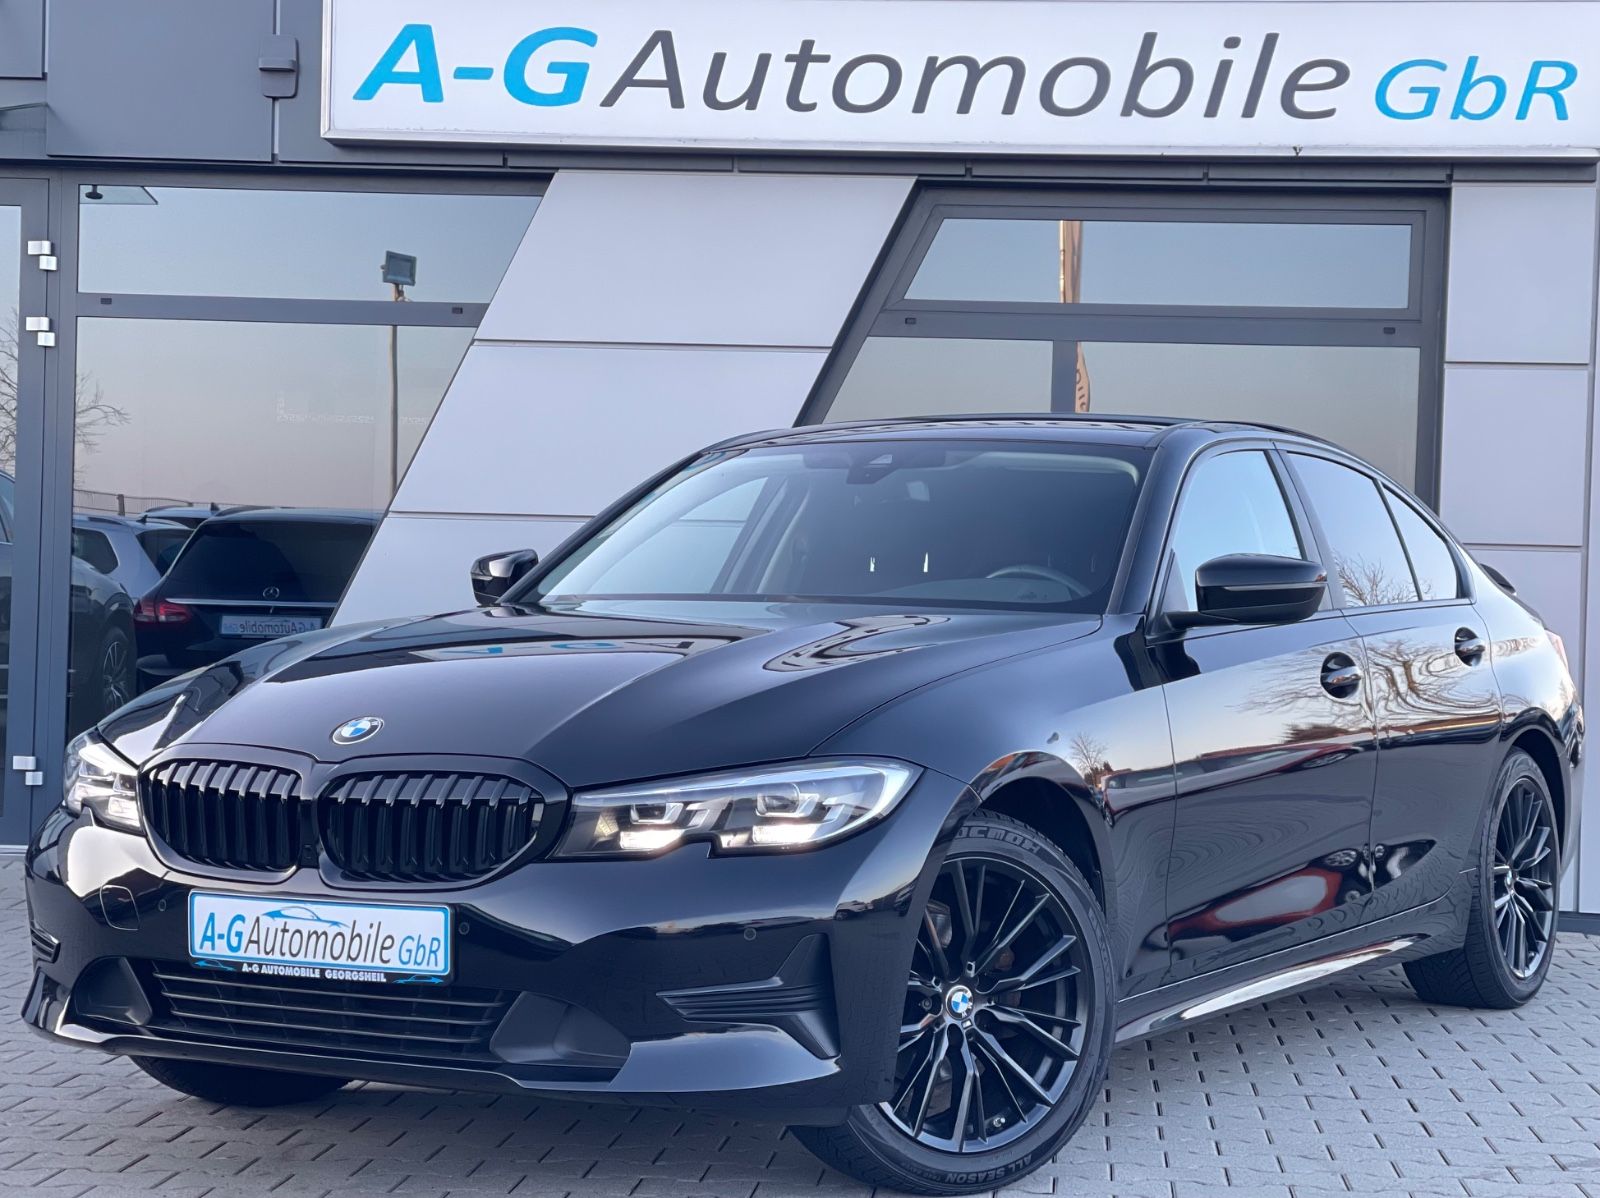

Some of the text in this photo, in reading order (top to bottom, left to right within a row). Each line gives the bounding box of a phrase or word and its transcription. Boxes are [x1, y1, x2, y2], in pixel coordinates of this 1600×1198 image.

[1375, 55, 1578, 121] GbR
[398, 934, 441, 967] GbR
[242, 963, 387, 983] A-G AUTOMOBILE GEORGSHEIL
[1008, 1153, 1032, 1171] ALL
[945, 1168, 1006, 1184] SEASON
